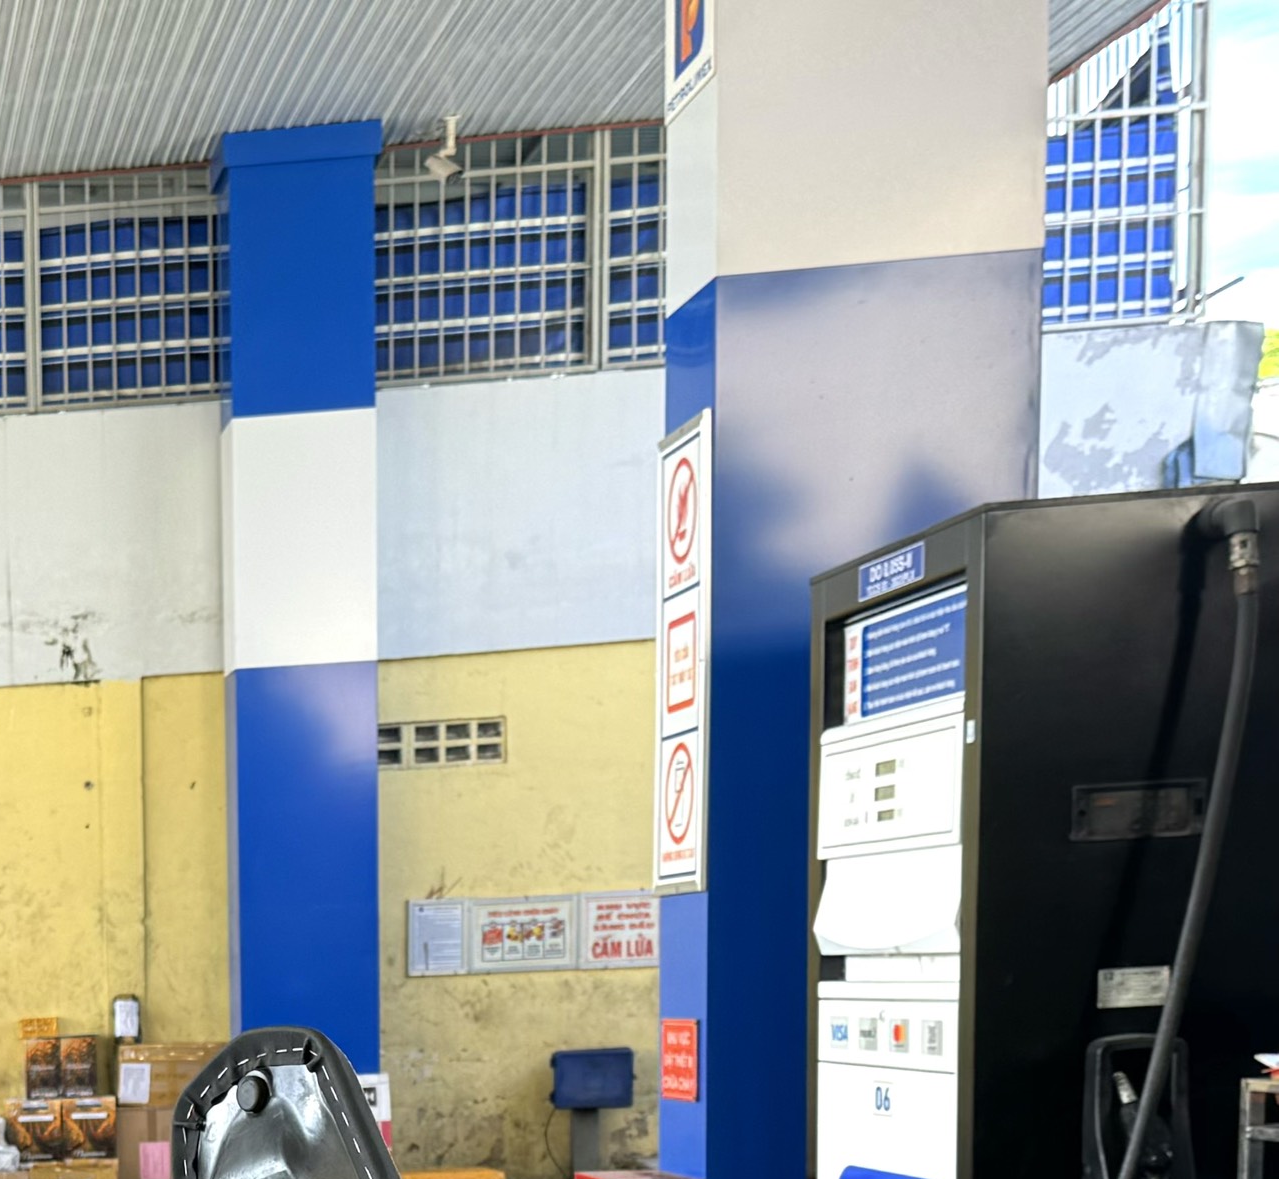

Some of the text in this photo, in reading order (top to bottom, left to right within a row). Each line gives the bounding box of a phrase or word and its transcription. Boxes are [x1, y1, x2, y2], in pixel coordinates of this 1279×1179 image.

[591, 933, 654, 959] CẤM LỬA
[875, 1086, 891, 1111] 06
